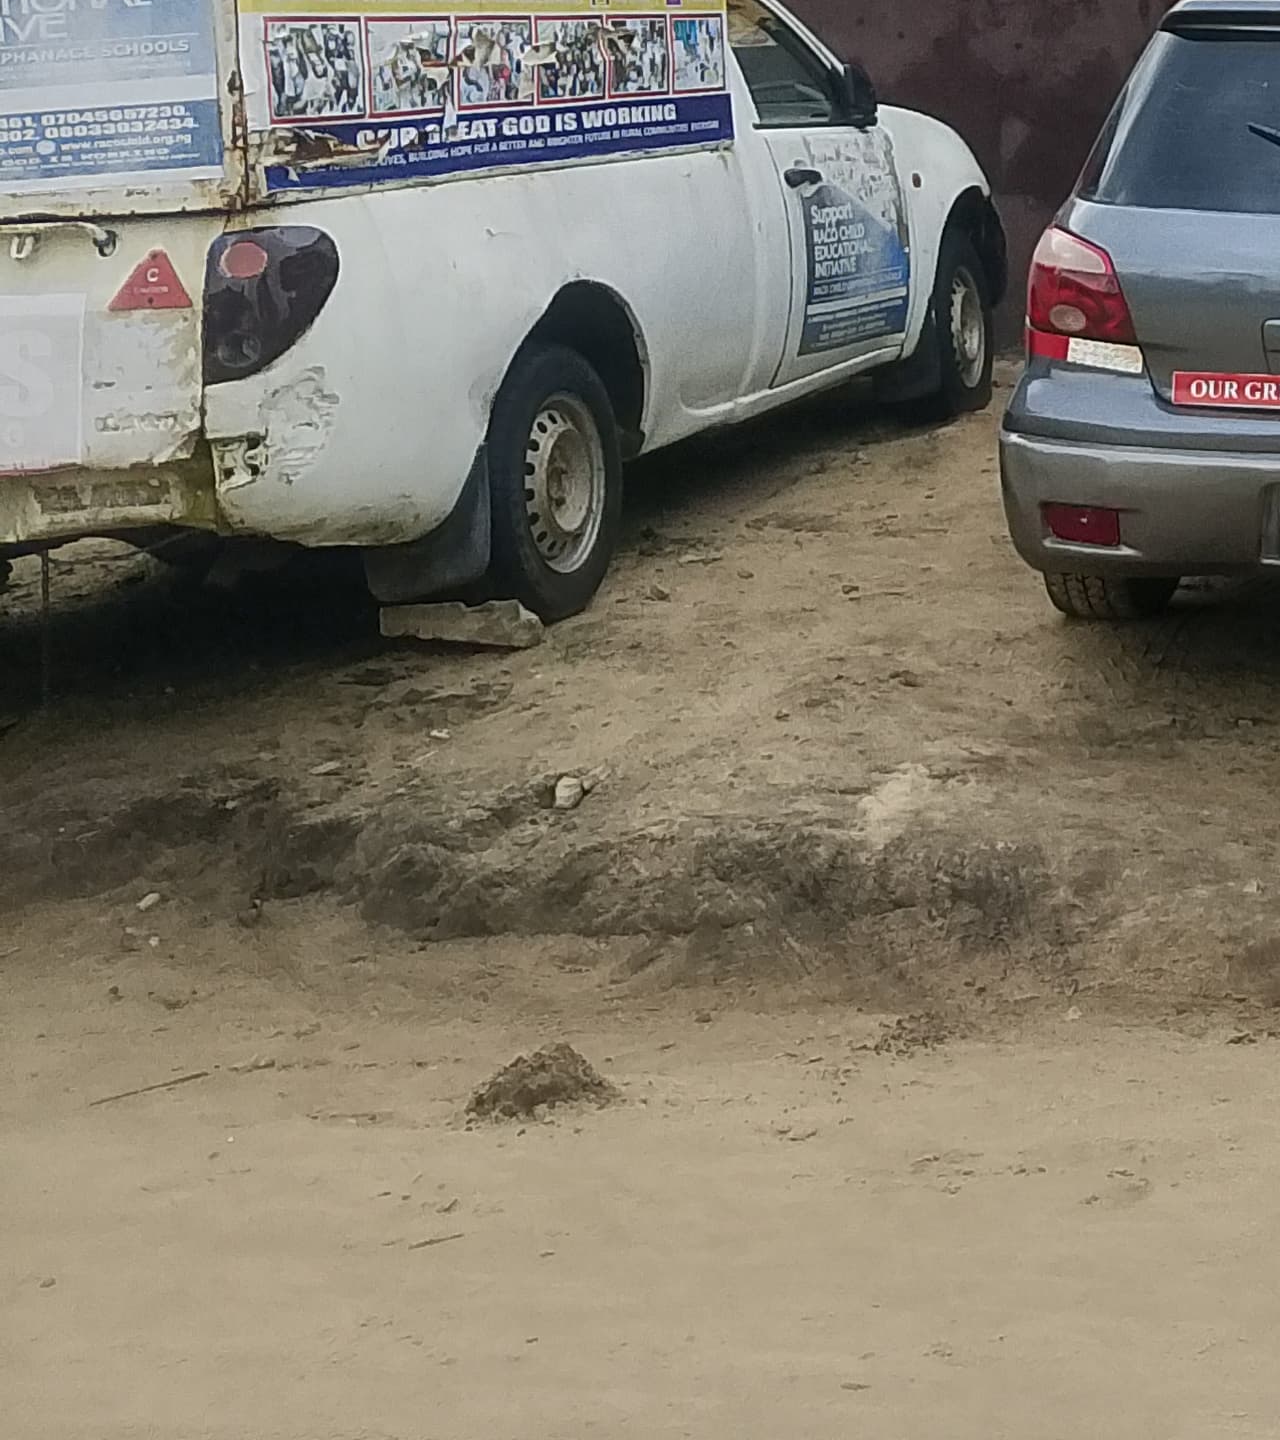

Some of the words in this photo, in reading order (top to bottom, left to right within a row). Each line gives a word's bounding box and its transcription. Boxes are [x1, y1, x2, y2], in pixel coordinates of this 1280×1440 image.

[502, 114, 551, 137] GOD
[555, 112, 578, 132] IS
[581, 103, 677, 130] WORKING
[1190, 379, 1239, 401] OUR
